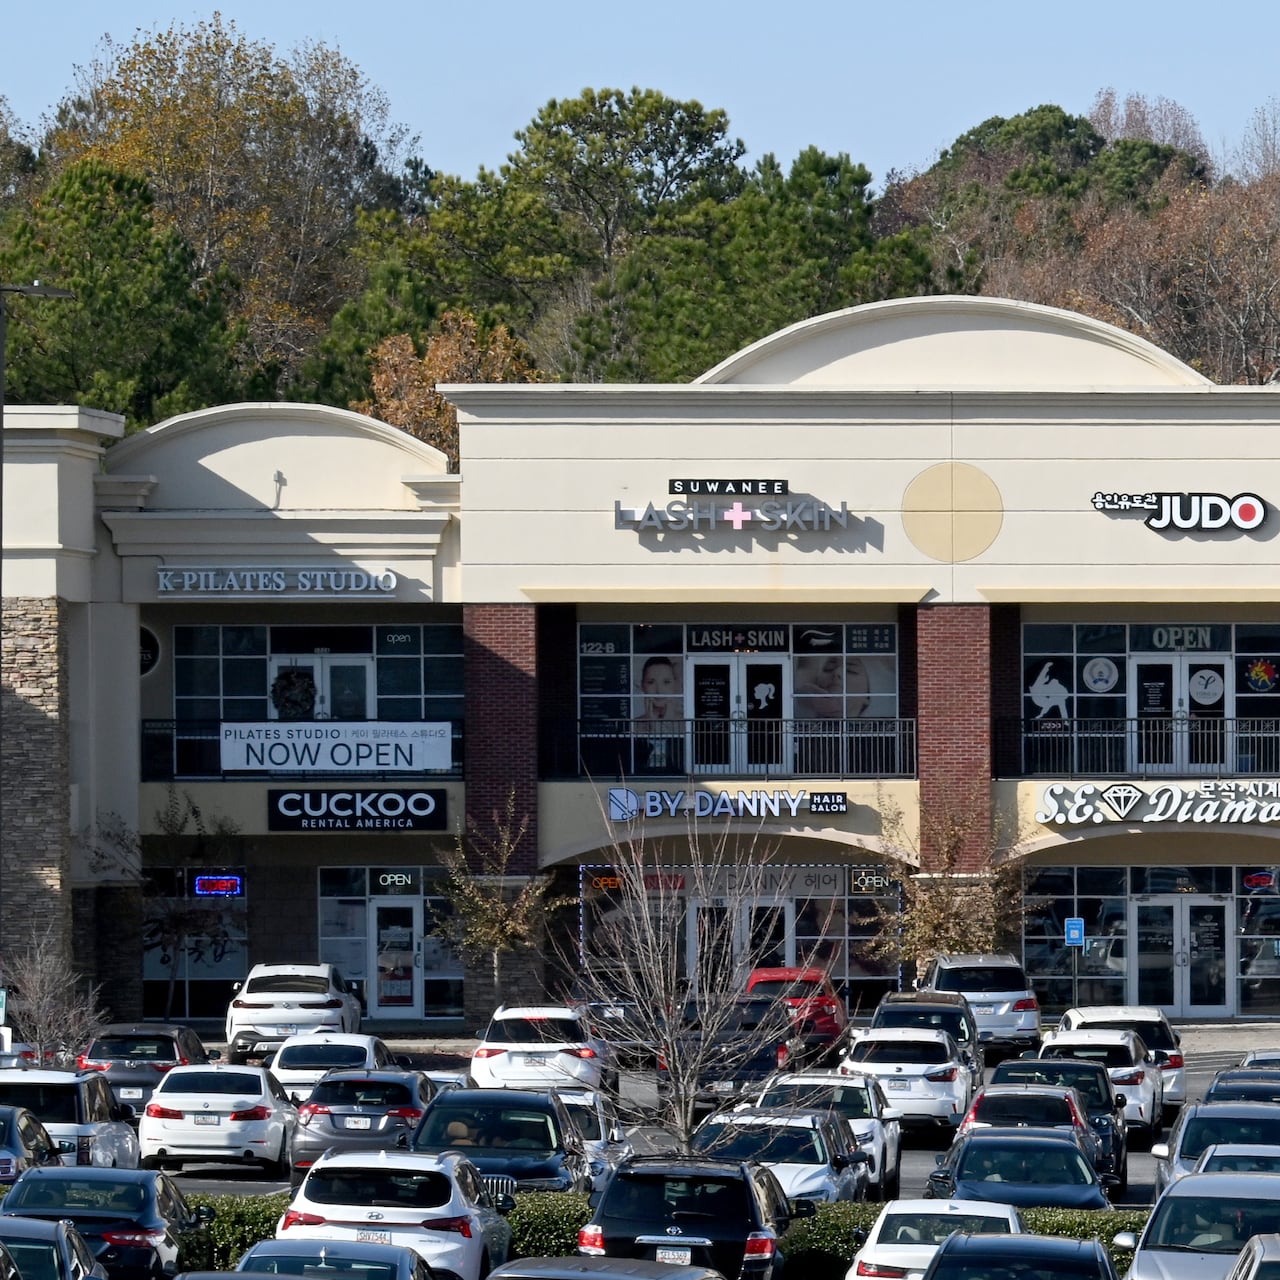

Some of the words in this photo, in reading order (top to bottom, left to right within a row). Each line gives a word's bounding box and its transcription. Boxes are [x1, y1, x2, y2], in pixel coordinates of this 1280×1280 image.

[674, 480, 783, 494] SUWANEE
[614, 499, 716, 530] LASH
[760, 500, 848, 531] SKIN
[1149, 495, 1265, 530] JUDO
[158, 571, 286, 592] K-PILATES
[298, 571, 397, 593] STUDIO
[387, 633, 411, 644] open
[691, 630, 733, 647] LASH
[748, 630, 785, 647] SKIN
[1152, 626, 1212, 649] OPEN
[581, 642, 615, 653] 122-B
[224, 729, 281, 740] PILATES
[287, 729, 340, 739] STUDIO
[350, 728, 370, 739] 케이
[372, 728, 407, 739] 필라테스
[410, 728, 447, 739] 스튜디오
[246, 742, 321, 766] NOW
[330, 742, 414, 767] OPEN
[278, 793, 436, 817] CUCKOO
[694, 790, 807, 818] DANNY
[813, 795, 843, 804] HAIR
[811, 804, 847, 812] SALON
[301, 818, 350, 828] RENTAL
[356, 818, 414, 828] AMERICA
[199, 878, 237, 892] open
[379, 873, 412, 887] OPEN
[804, 873, 838, 890] 헤어
[857, 875, 889, 888] OPEN
